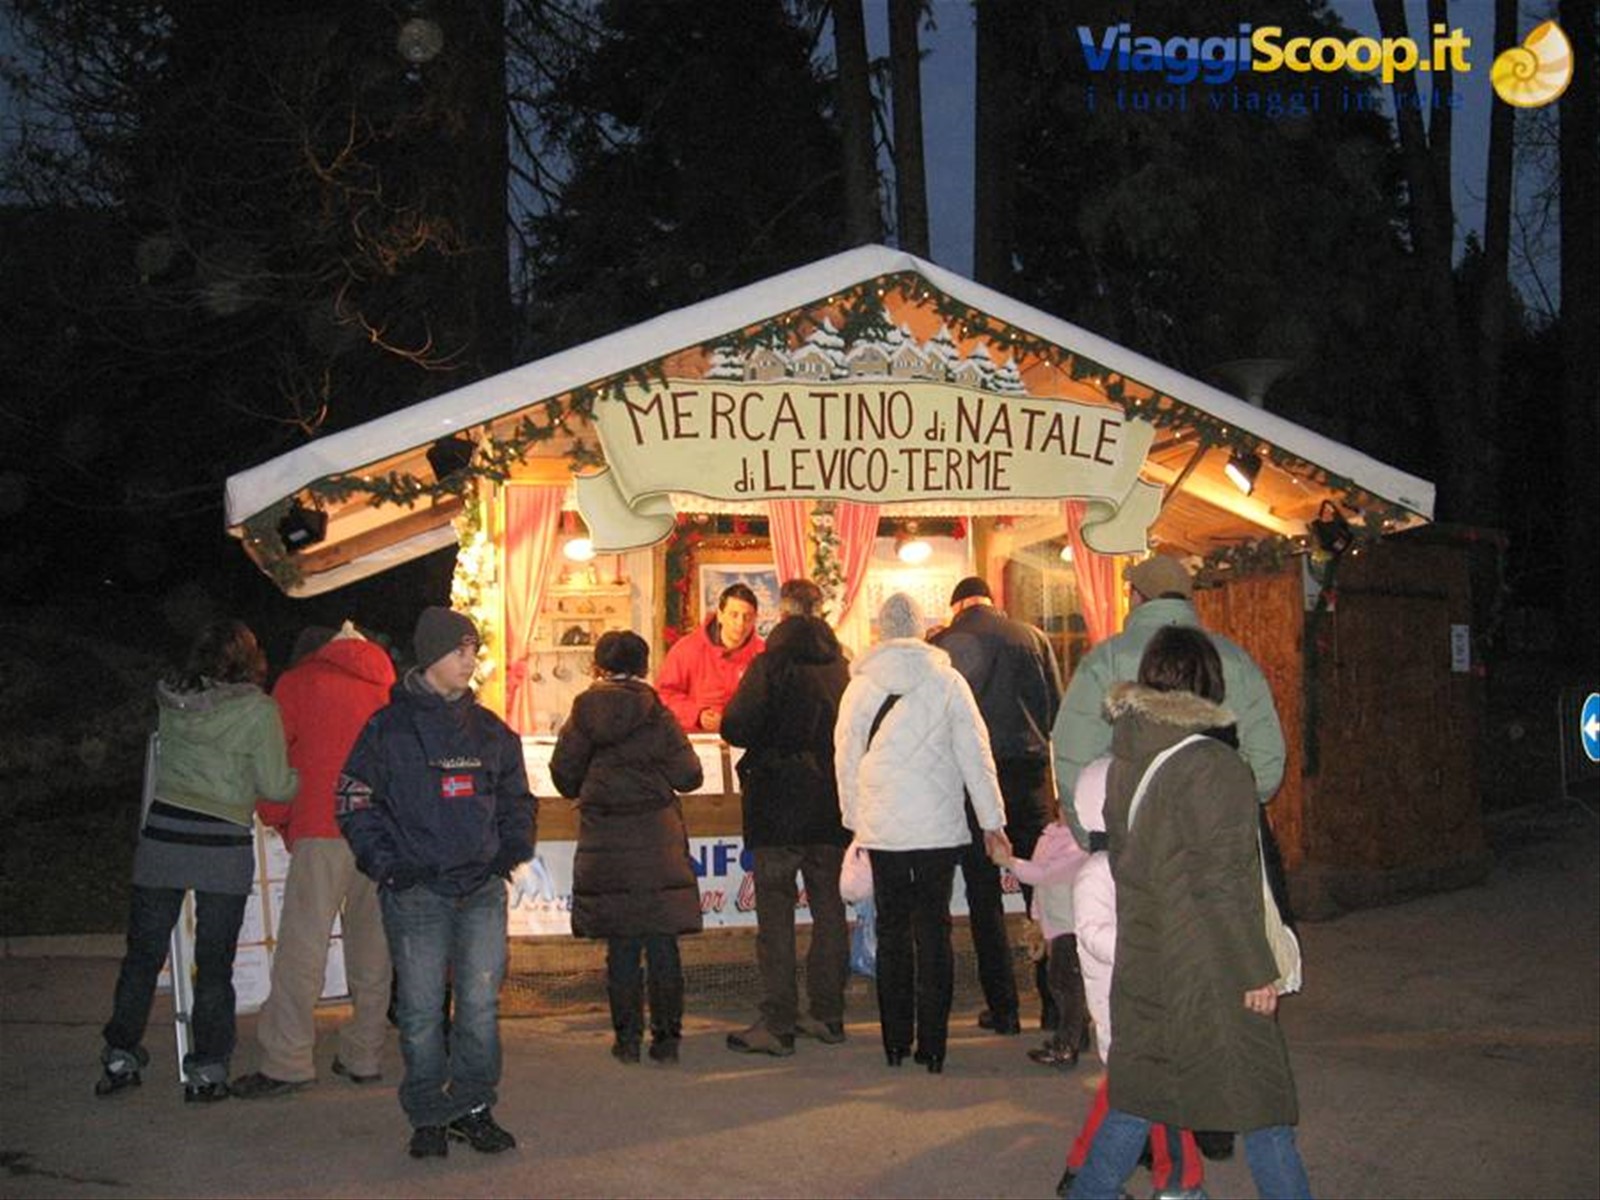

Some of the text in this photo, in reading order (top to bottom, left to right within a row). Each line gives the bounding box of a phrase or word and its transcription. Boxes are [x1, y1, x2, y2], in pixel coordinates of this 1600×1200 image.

[624, 390, 1121, 466] MERCATINO di NATALE
[734, 447, 1012, 493] di LEVICO-TERME
